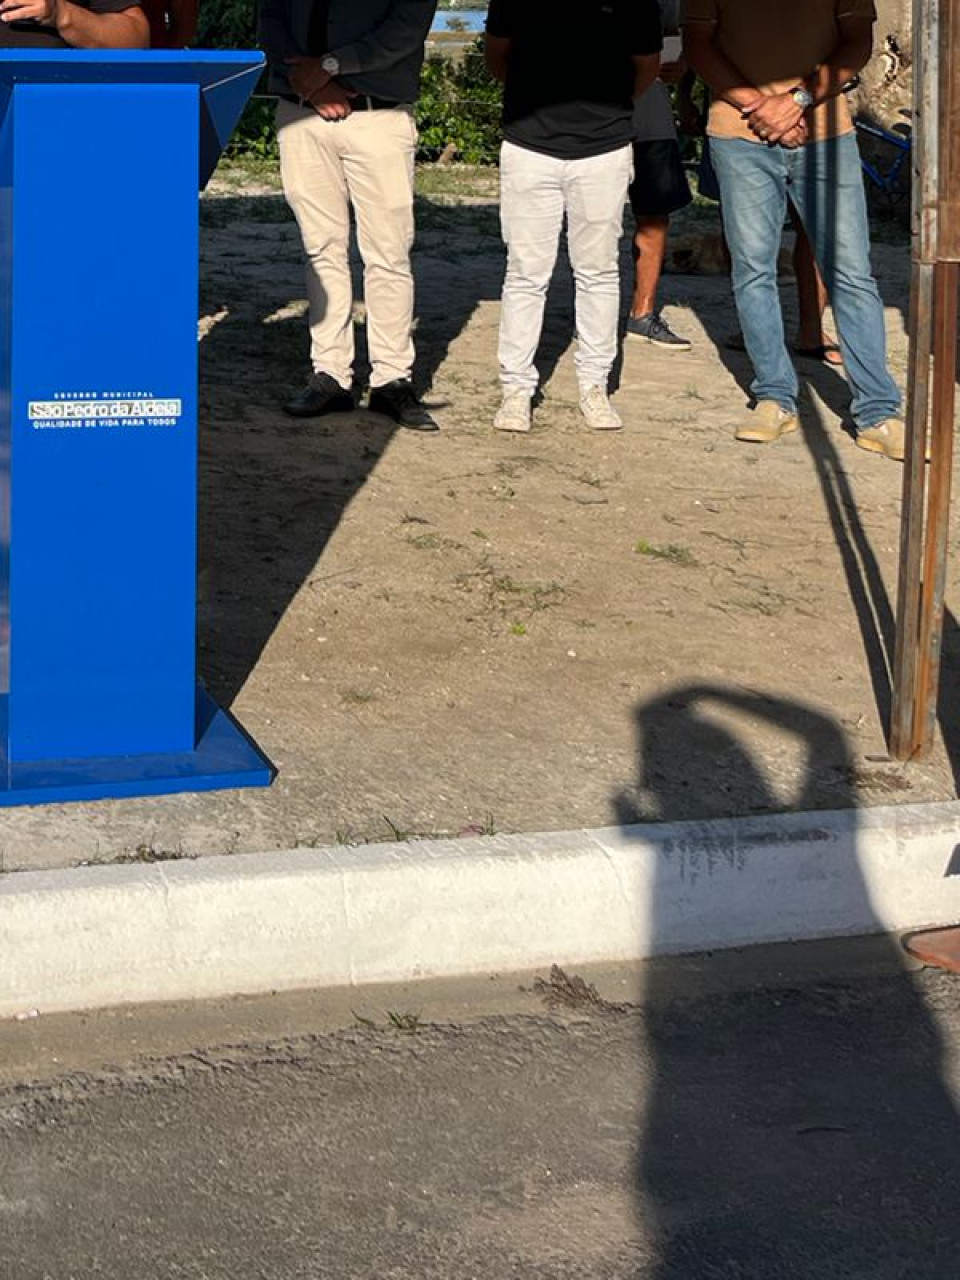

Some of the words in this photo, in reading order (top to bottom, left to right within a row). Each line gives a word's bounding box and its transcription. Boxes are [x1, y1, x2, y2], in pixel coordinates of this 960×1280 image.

[33, 419, 83, 429] QUALIDADE
[84, 419, 97, 428] DE
[99, 419, 119, 428] VIDA
[121, 419, 145, 427] PARA
[147, 418, 177, 427] TODOS
